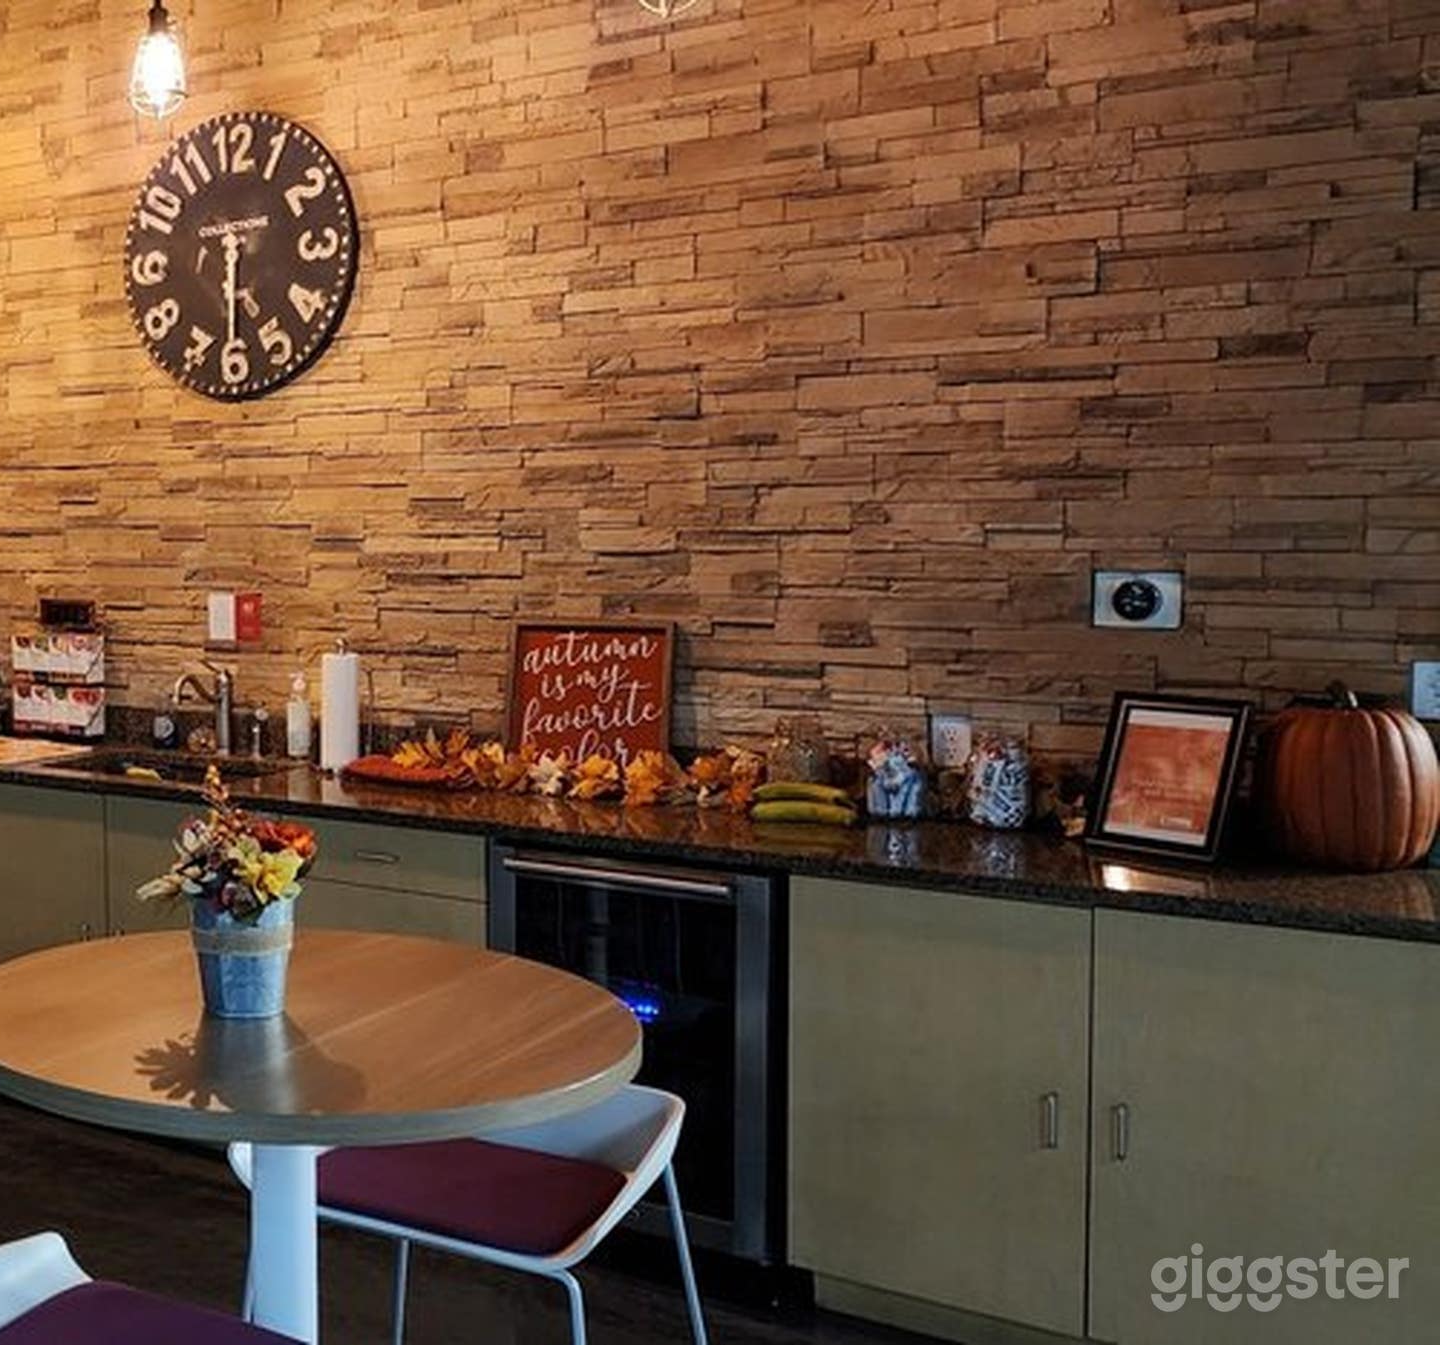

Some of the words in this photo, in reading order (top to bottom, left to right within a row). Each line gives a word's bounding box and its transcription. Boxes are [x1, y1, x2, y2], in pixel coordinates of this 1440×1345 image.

[170, 142, 212, 196] 11
[212, 123, 256, 174] 12
[263, 131, 288, 180] 1
[139, 185, 182, 235] 10
[284, 166, 327, 217] 2
[298, 226, 339, 262] 3
[144, 298, 180, 341] 8
[288, 283, 329, 323] 4
[184, 325, 216, 371] 7
[221, 338, 249, 384] 6
[258, 317, 293, 366] 5
[522, 630, 659, 675] autumn
[541, 673, 574, 700] is
[576, 663, 630, 704] my
[521, 679, 662, 745] favorite
